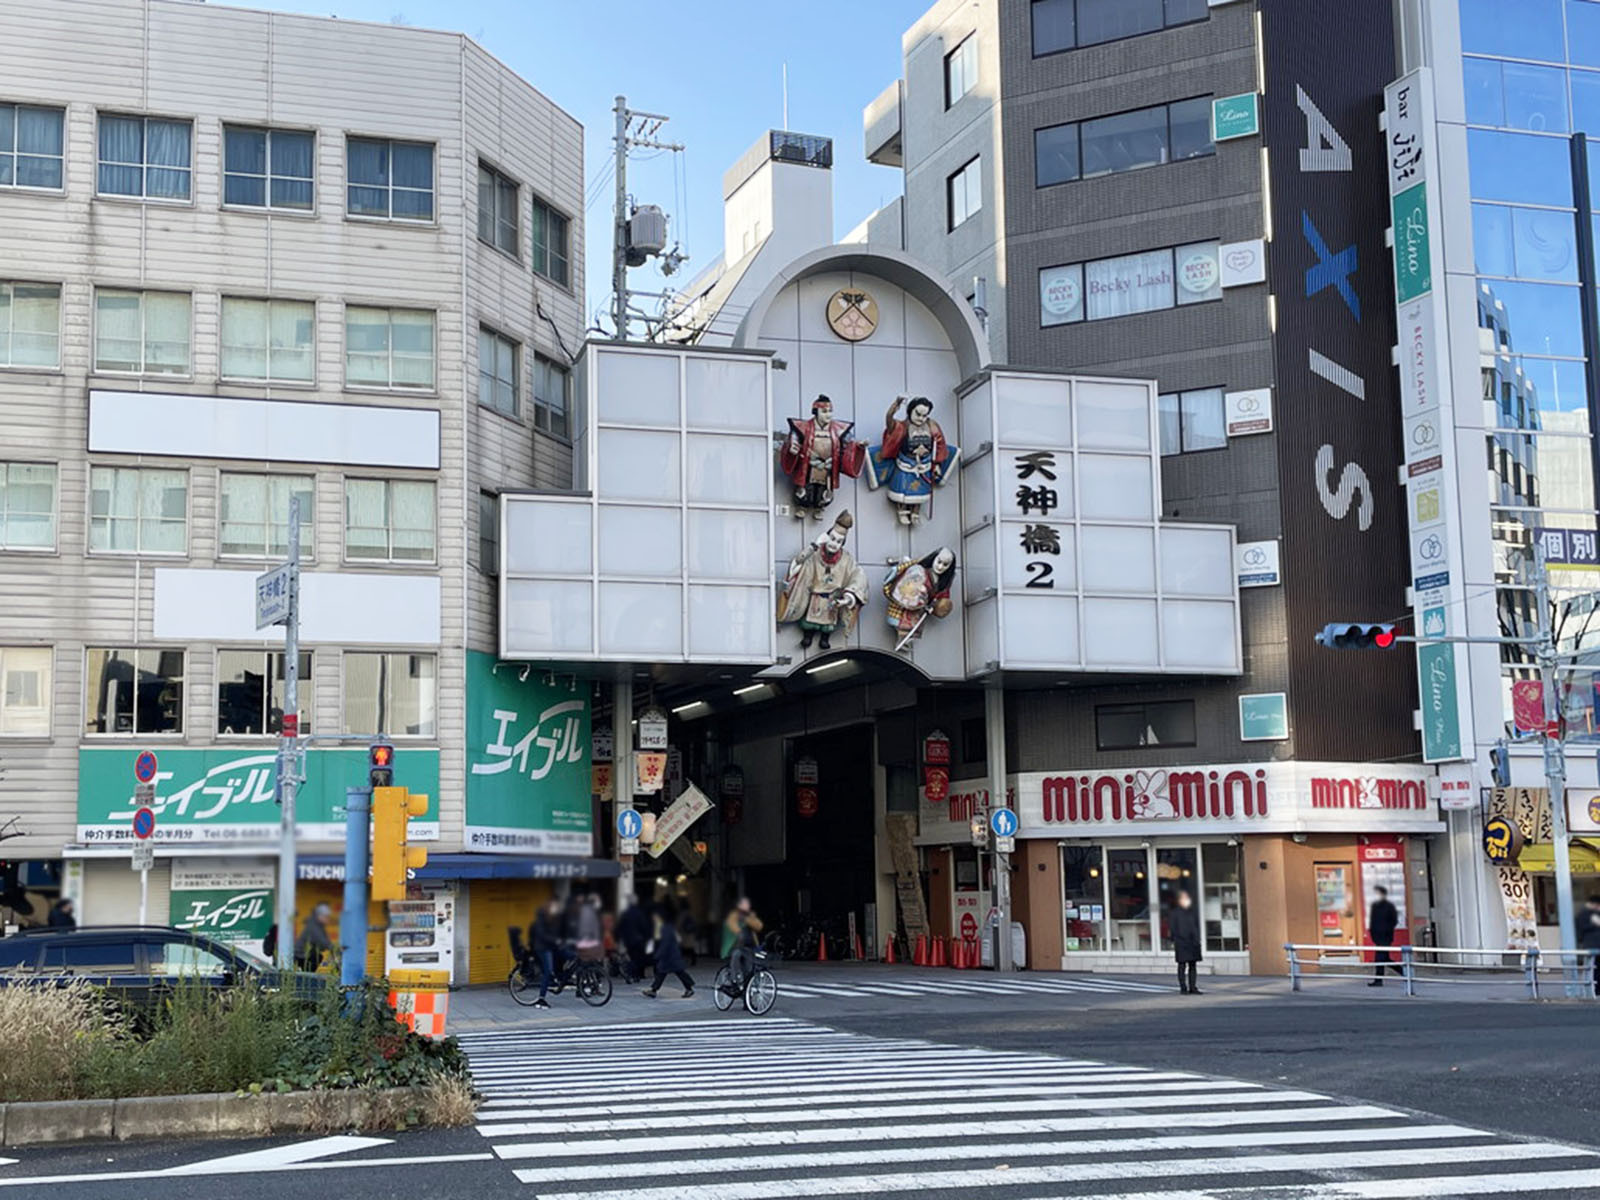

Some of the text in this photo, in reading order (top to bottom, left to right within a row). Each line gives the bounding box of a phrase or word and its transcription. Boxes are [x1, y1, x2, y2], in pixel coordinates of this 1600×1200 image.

[1398, 86, 1410, 119] bar
[1090, 269, 1171, 295] Becky Lash
[1185, 262, 1211, 273] BECKY
[1186, 269, 1212, 280] LASH
[1048, 285, 1073, 295] BECKY
[1049, 292, 1073, 302] LASH
[1296, 83, 1374, 531] AXIS
[1414, 326, 1427, 406] BECKY LASH
[1014, 451, 1061, 589] 天神橋2
[1540, 532, 1596, 560] 個別
[472, 700, 585, 781] エイブル
[108, 755, 277, 820] エイブル
[1042, 768, 1269, 823] mini mini
[1311, 777, 1427, 810] mini mini
[1499, 868, 1530, 883] うどん
[175, 891, 270, 929] エイブル
